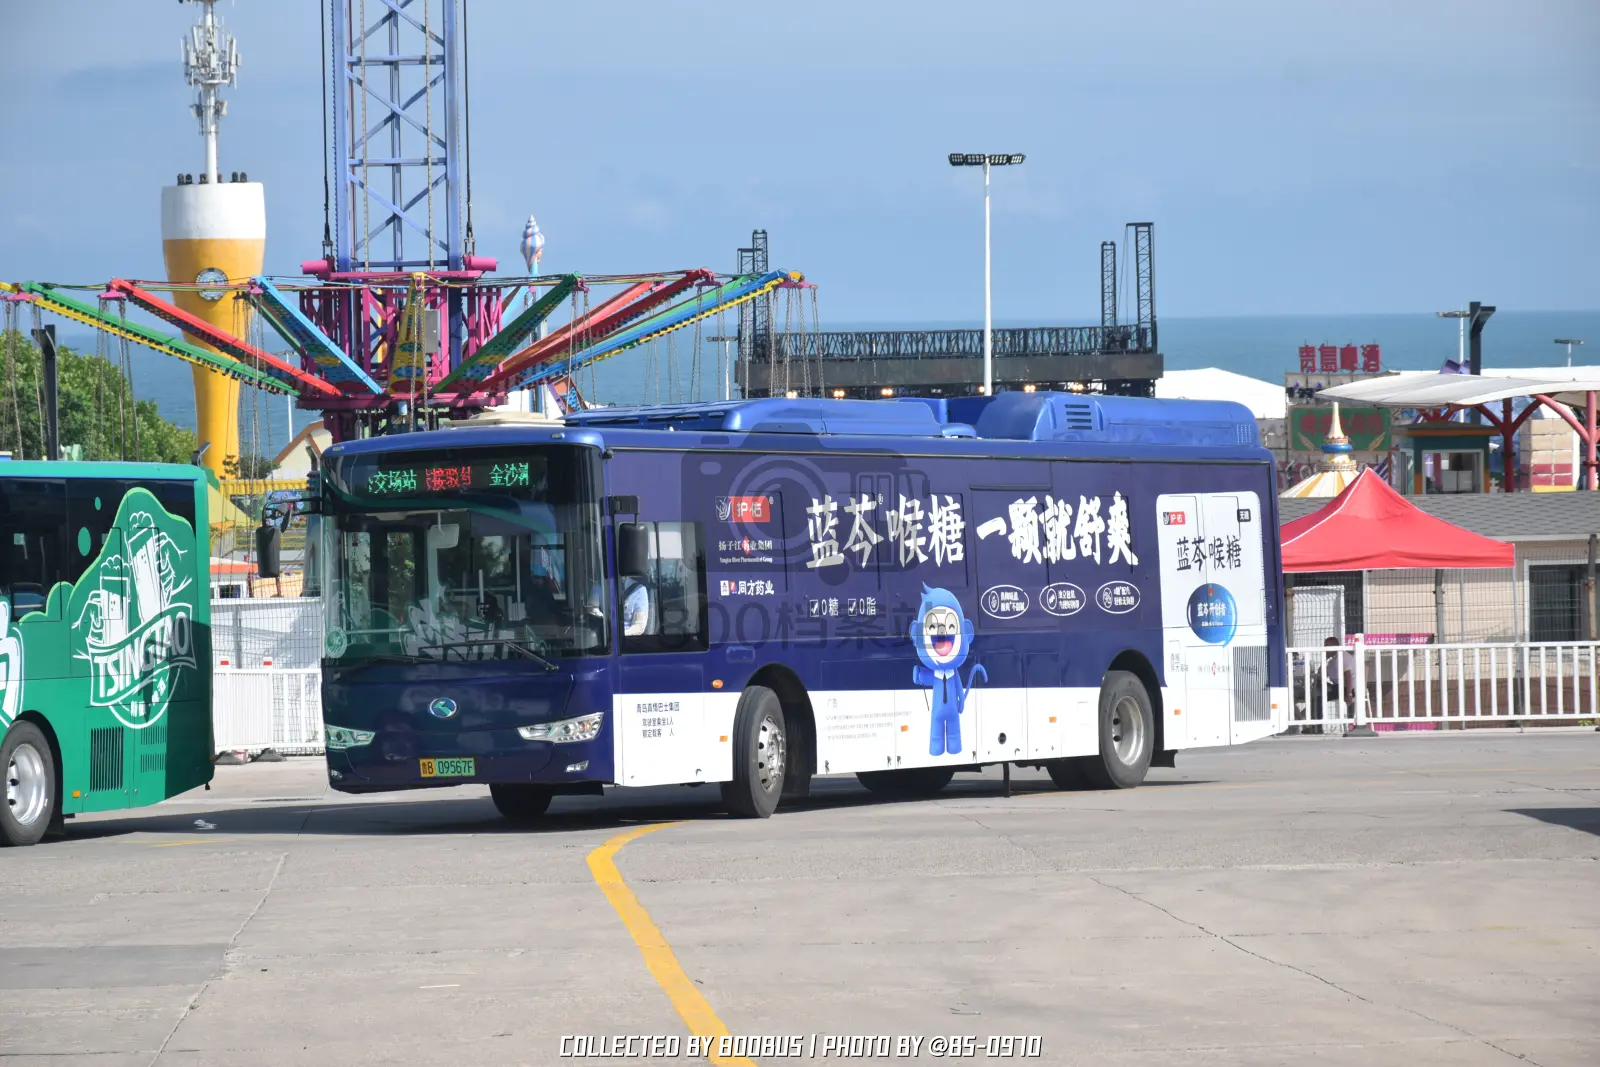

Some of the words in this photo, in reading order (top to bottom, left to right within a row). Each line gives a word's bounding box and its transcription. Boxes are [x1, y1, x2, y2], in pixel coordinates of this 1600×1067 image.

[976, 490, 1139, 566] 一颗就舒爽
[1176, 535, 1242, 572] 蓝芩喉糖
[93, 611, 189, 698] TSINGTAO
